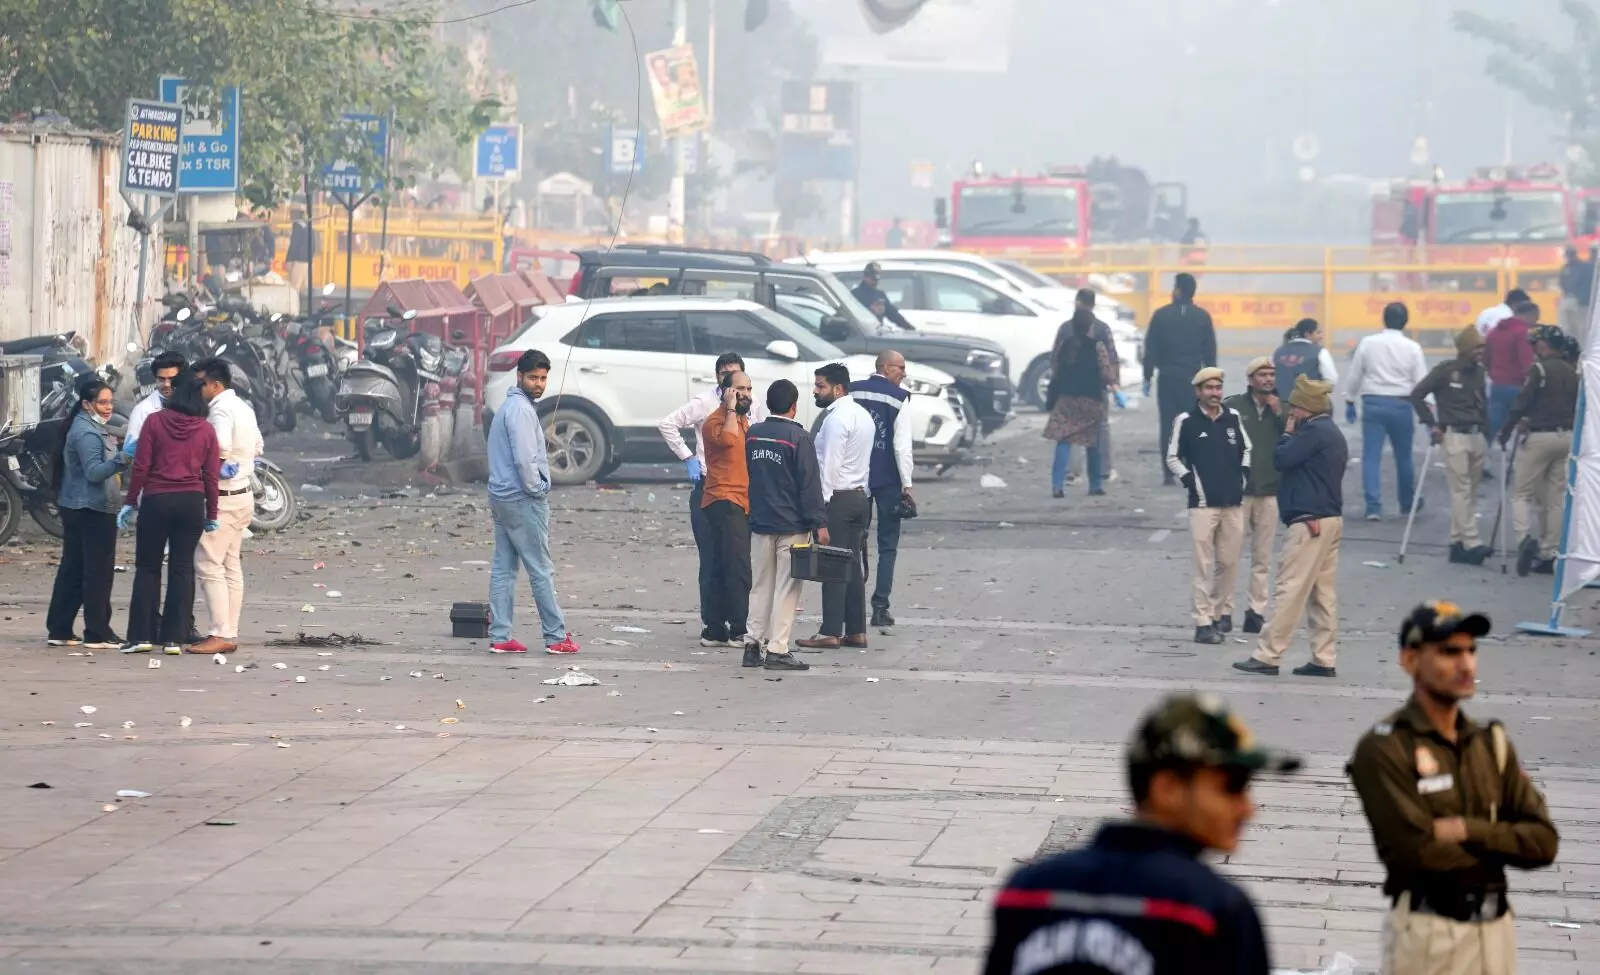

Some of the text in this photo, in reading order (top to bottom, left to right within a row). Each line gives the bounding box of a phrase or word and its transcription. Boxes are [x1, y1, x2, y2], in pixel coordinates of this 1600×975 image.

[131, 121, 177, 143] PARKING
[198, 141, 207, 153] &
[210, 141, 228, 153] Go
[195, 159, 203, 170] 5
[205, 158, 231, 171] TSR
